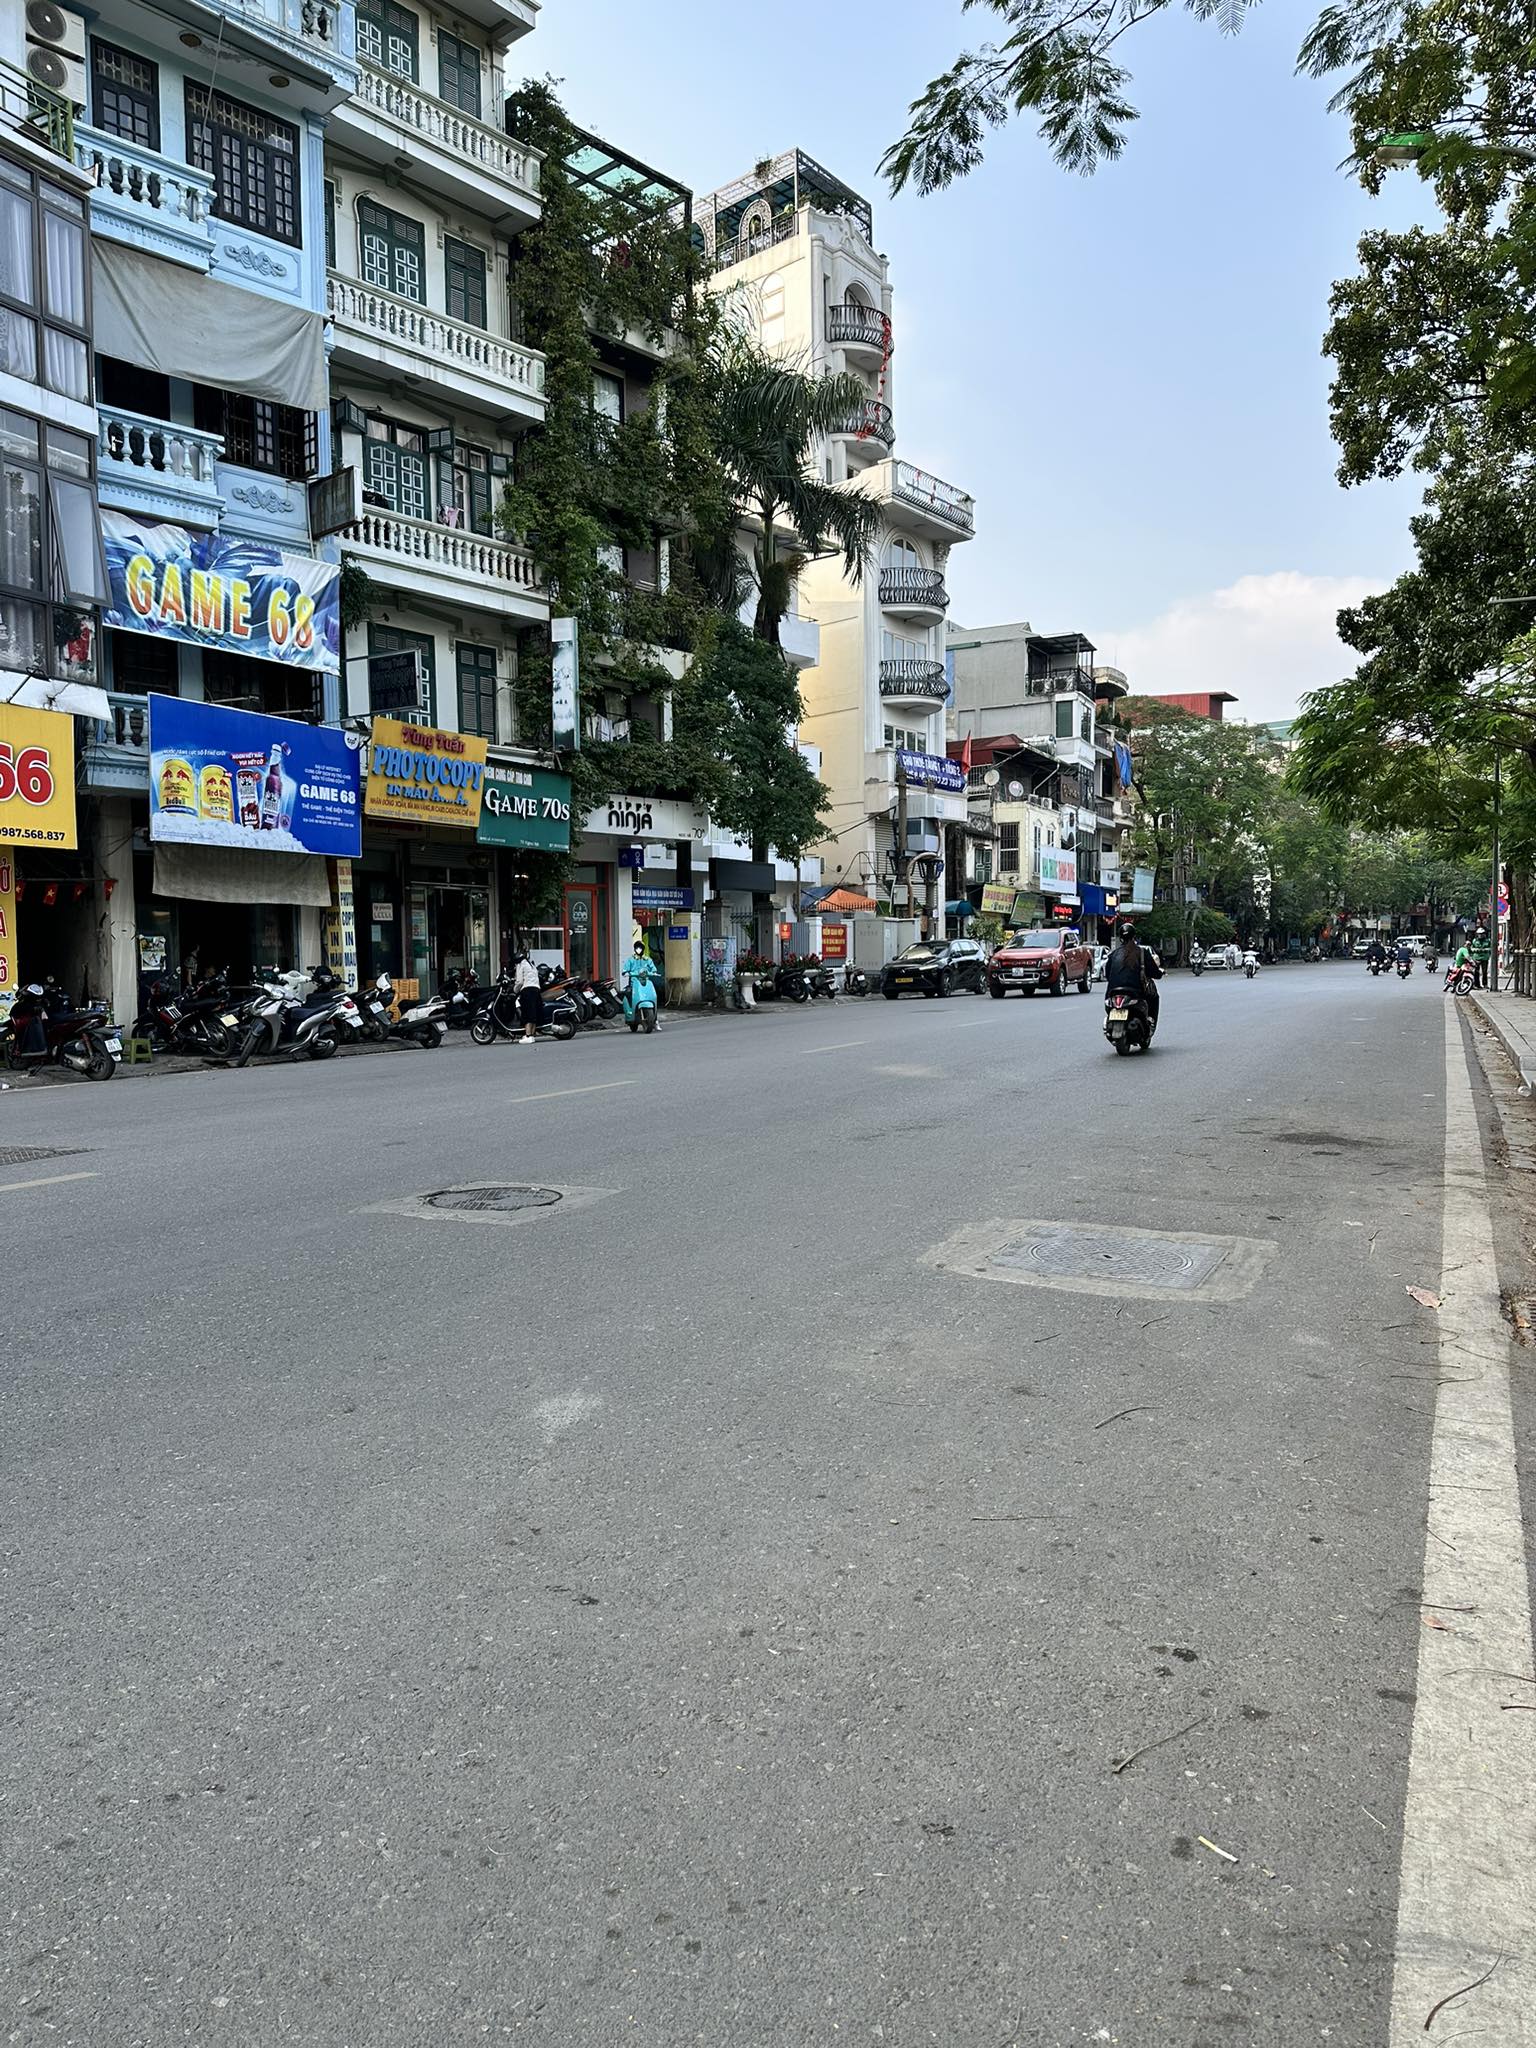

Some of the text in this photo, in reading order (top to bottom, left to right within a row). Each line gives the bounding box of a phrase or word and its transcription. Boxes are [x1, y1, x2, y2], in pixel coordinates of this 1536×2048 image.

[124, 553, 315, 650] GAME 68
[372, 744, 486, 790] PHOTOCOPY
[300, 784, 356, 804] GAME 68
[484, 787, 538, 820] GAME
[0, 827, 66, 842] 987.568.837
[345, 930, 354, 947] IN
